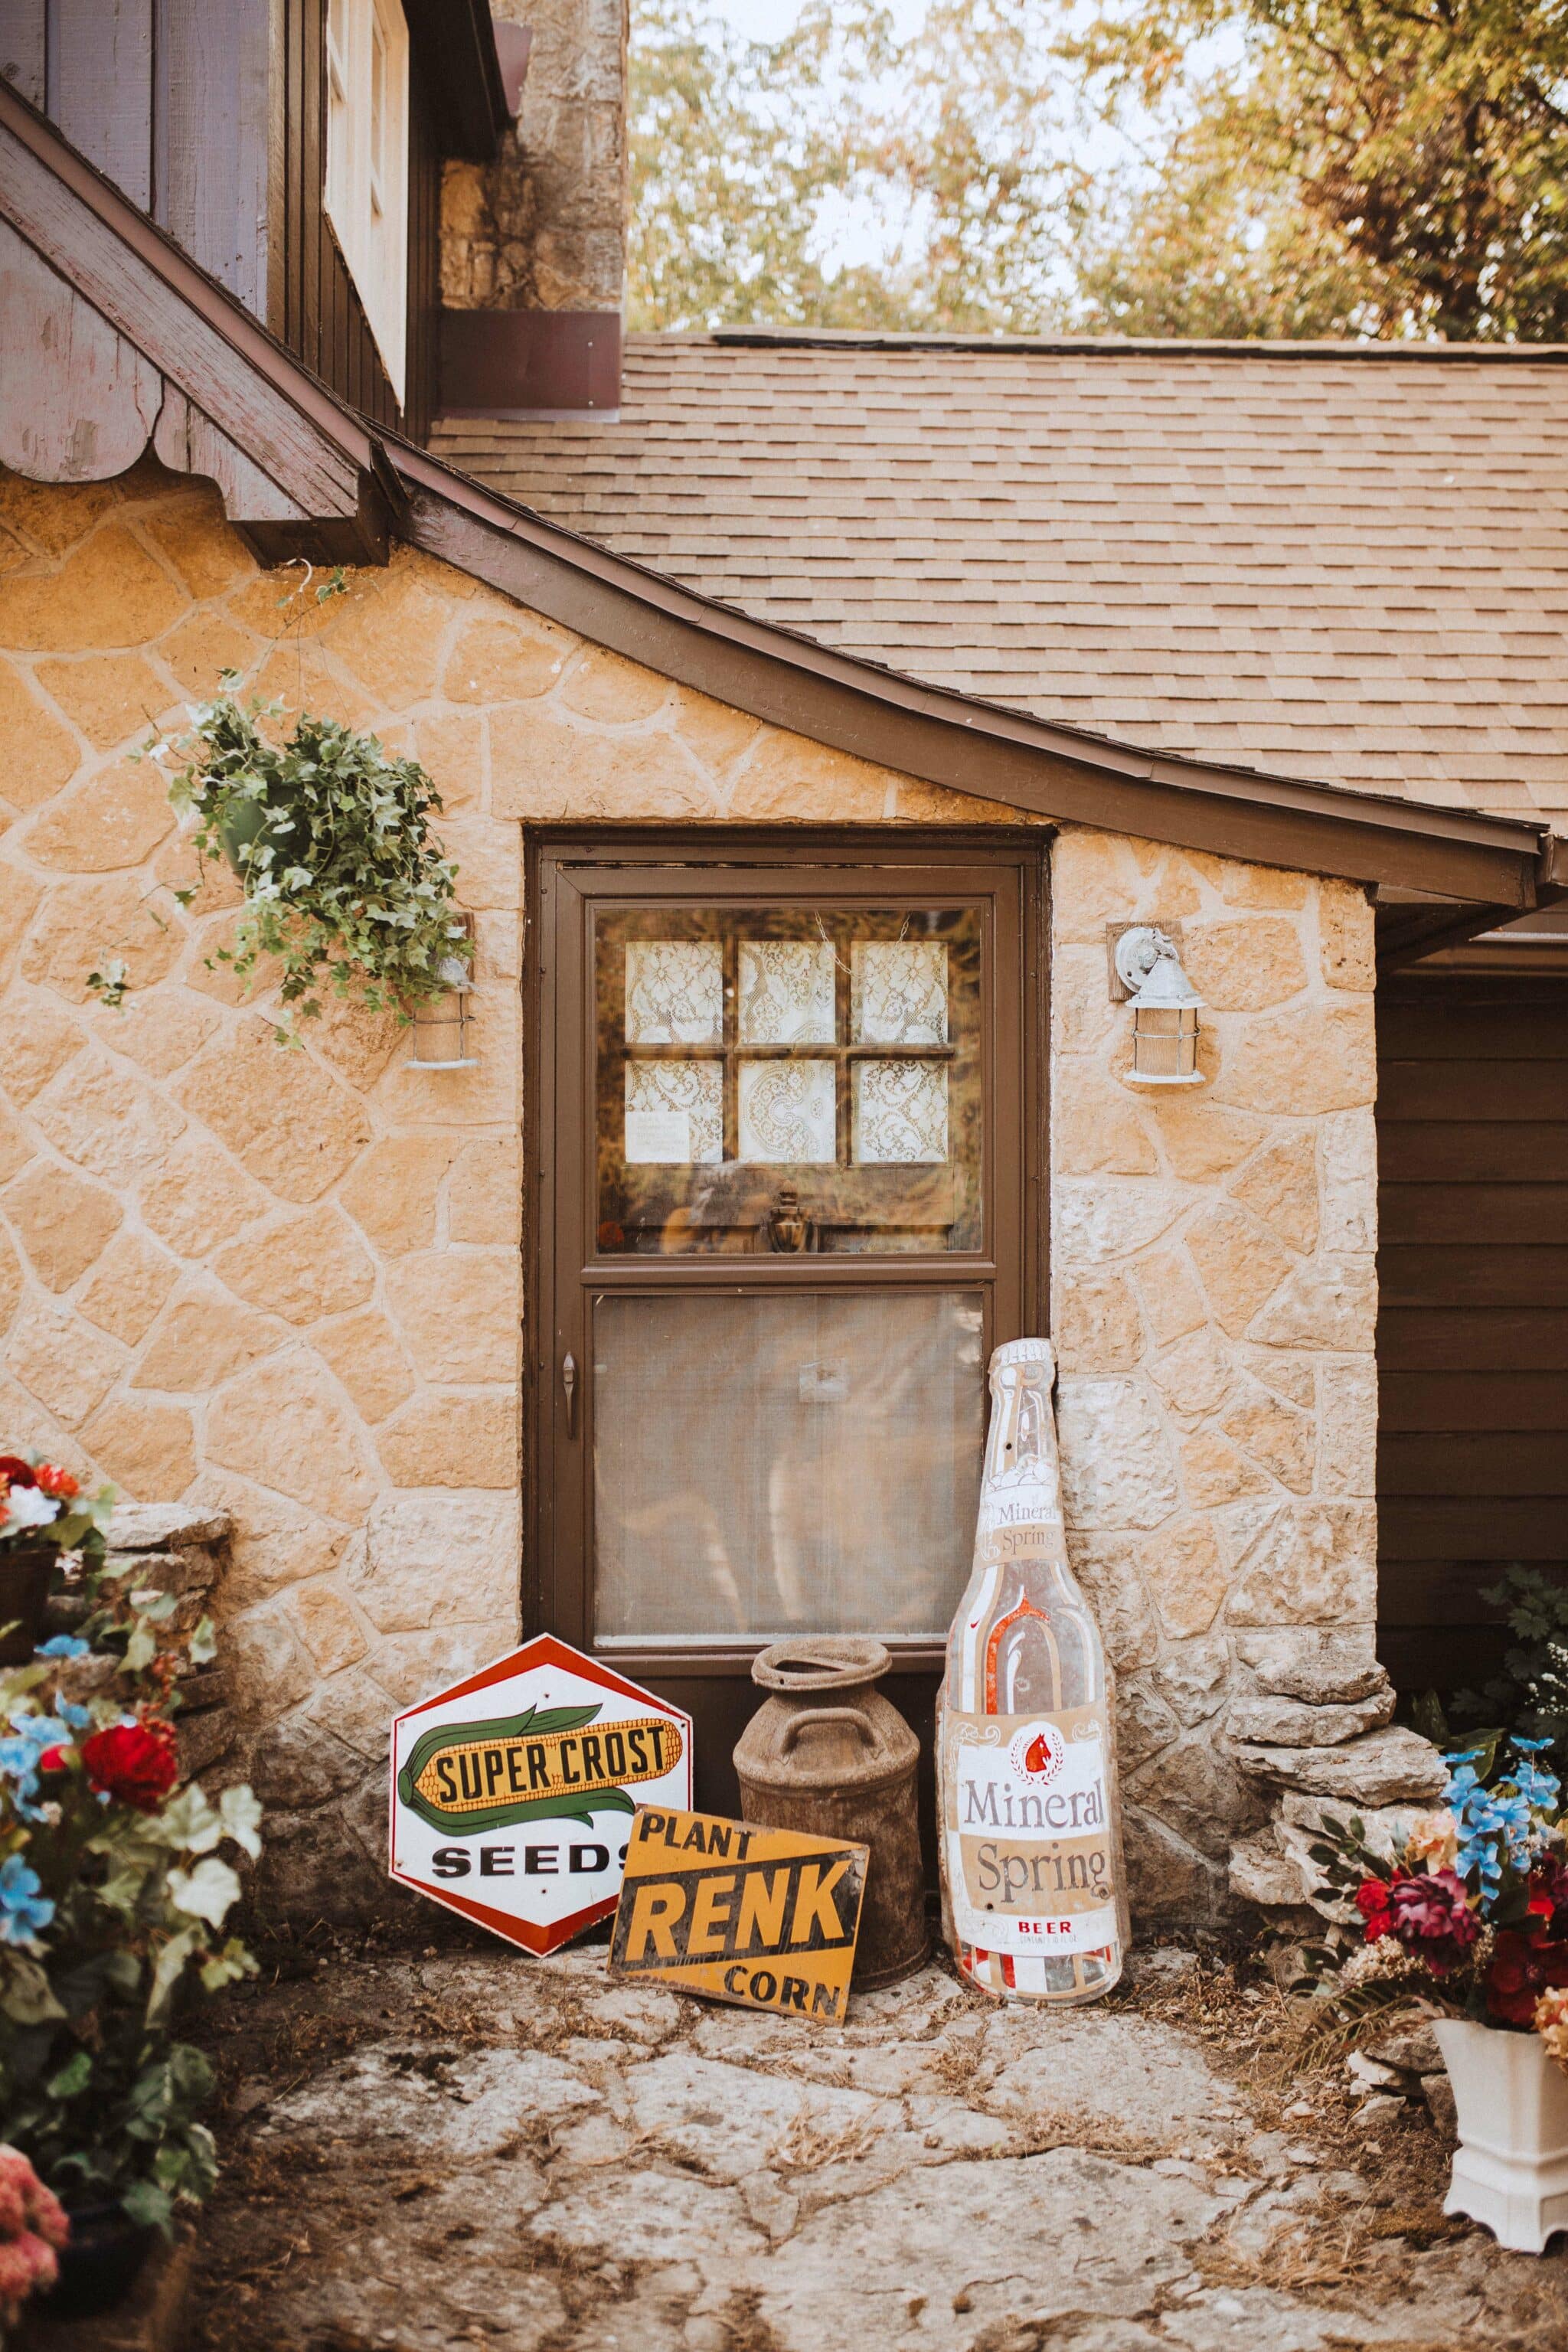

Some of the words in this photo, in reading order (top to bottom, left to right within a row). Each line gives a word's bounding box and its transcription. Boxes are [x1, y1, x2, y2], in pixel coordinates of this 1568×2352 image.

[1002, 1525, 1056, 1555] Spring
[436, 1742, 552, 1804] SUPER
[560, 1724, 665, 1785] CROST
[963, 1777, 1103, 1829] Mineral
[431, 1843, 629, 1879] SEED
[639, 1812, 752, 1860] PLANT
[977, 1842, 1110, 1903] Spring
[624, 1858, 854, 1963] RENK
[1018, 1920, 1071, 1935] BEER
[724, 1965, 841, 2017] CORN
